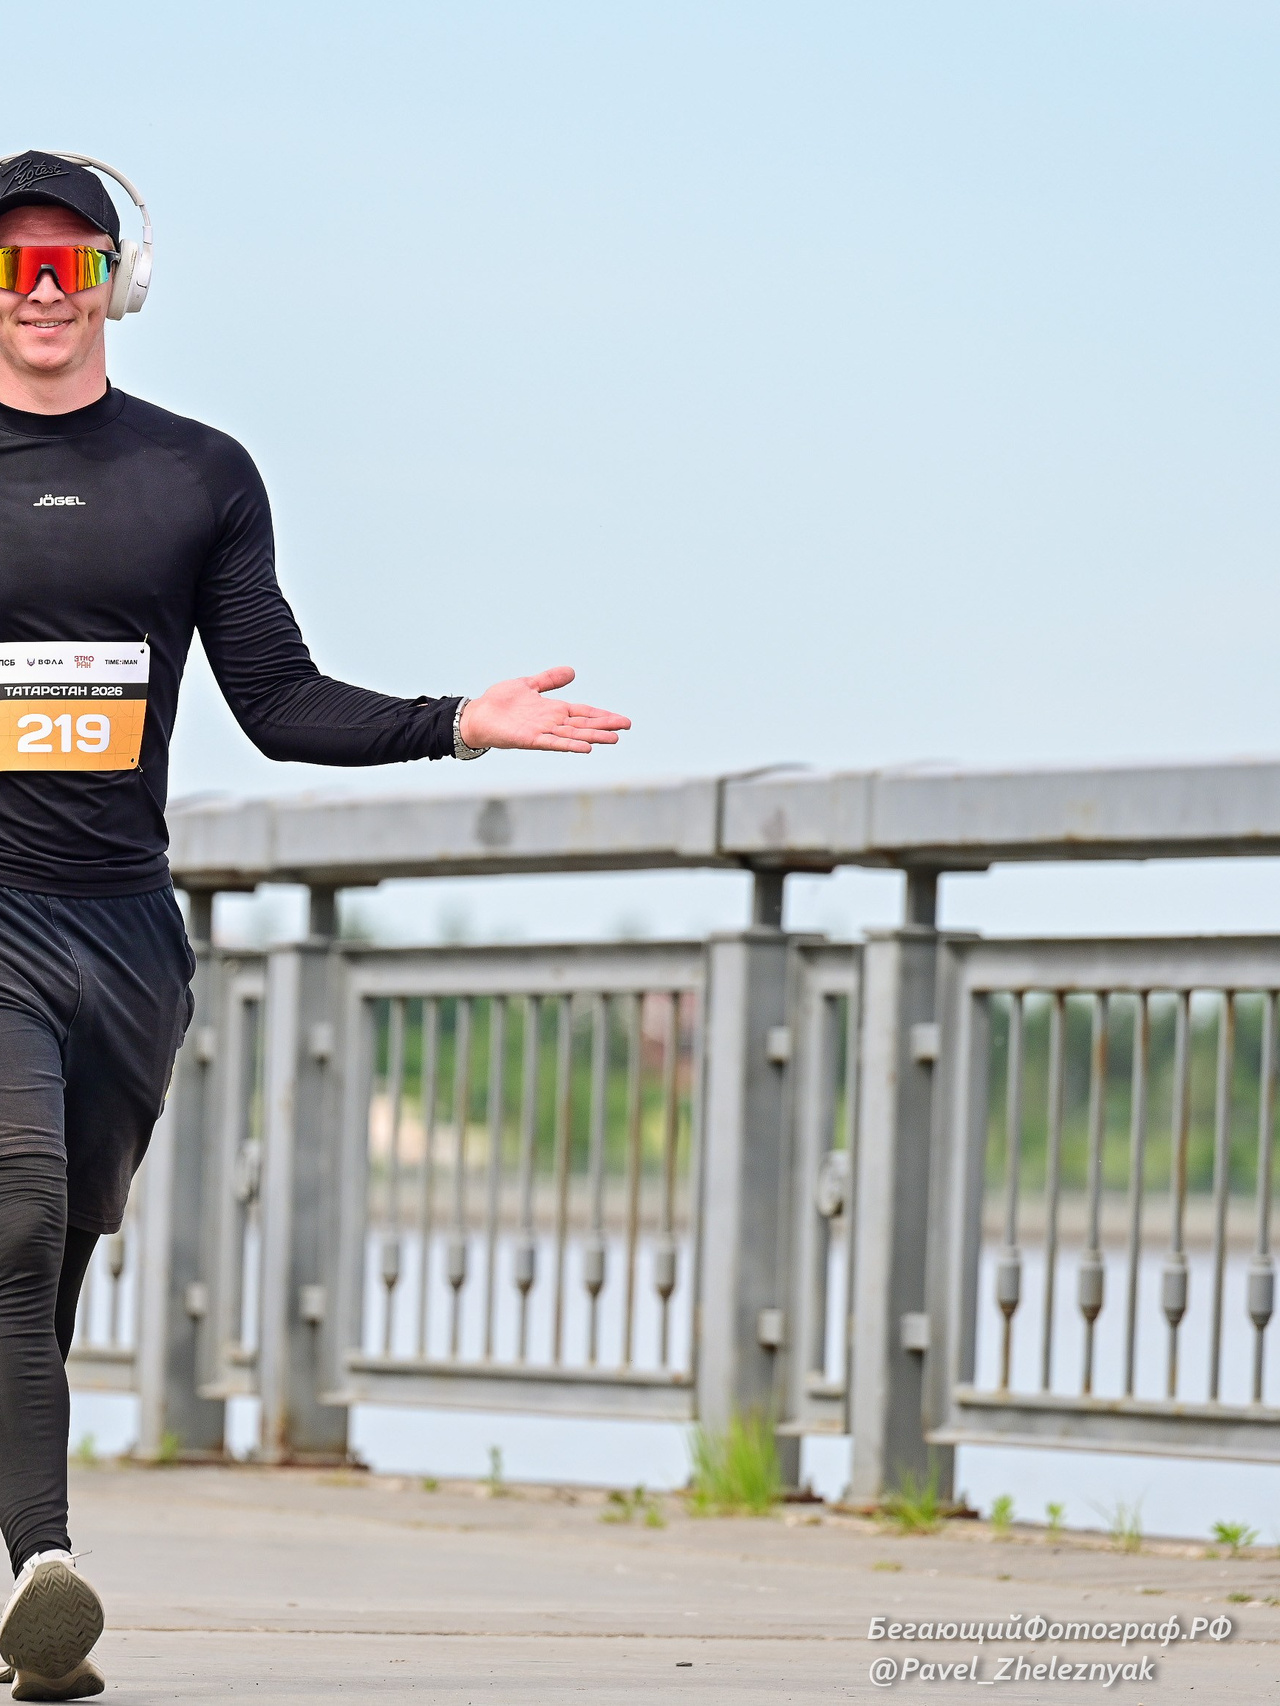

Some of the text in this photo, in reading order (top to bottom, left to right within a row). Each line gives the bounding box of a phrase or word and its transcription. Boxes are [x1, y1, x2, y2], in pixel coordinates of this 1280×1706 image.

[33, 494, 86, 506] JÖGEL
[4, 686, 123, 697] ТАТАРСТАН 2026
[17, 713, 111, 753] 219
